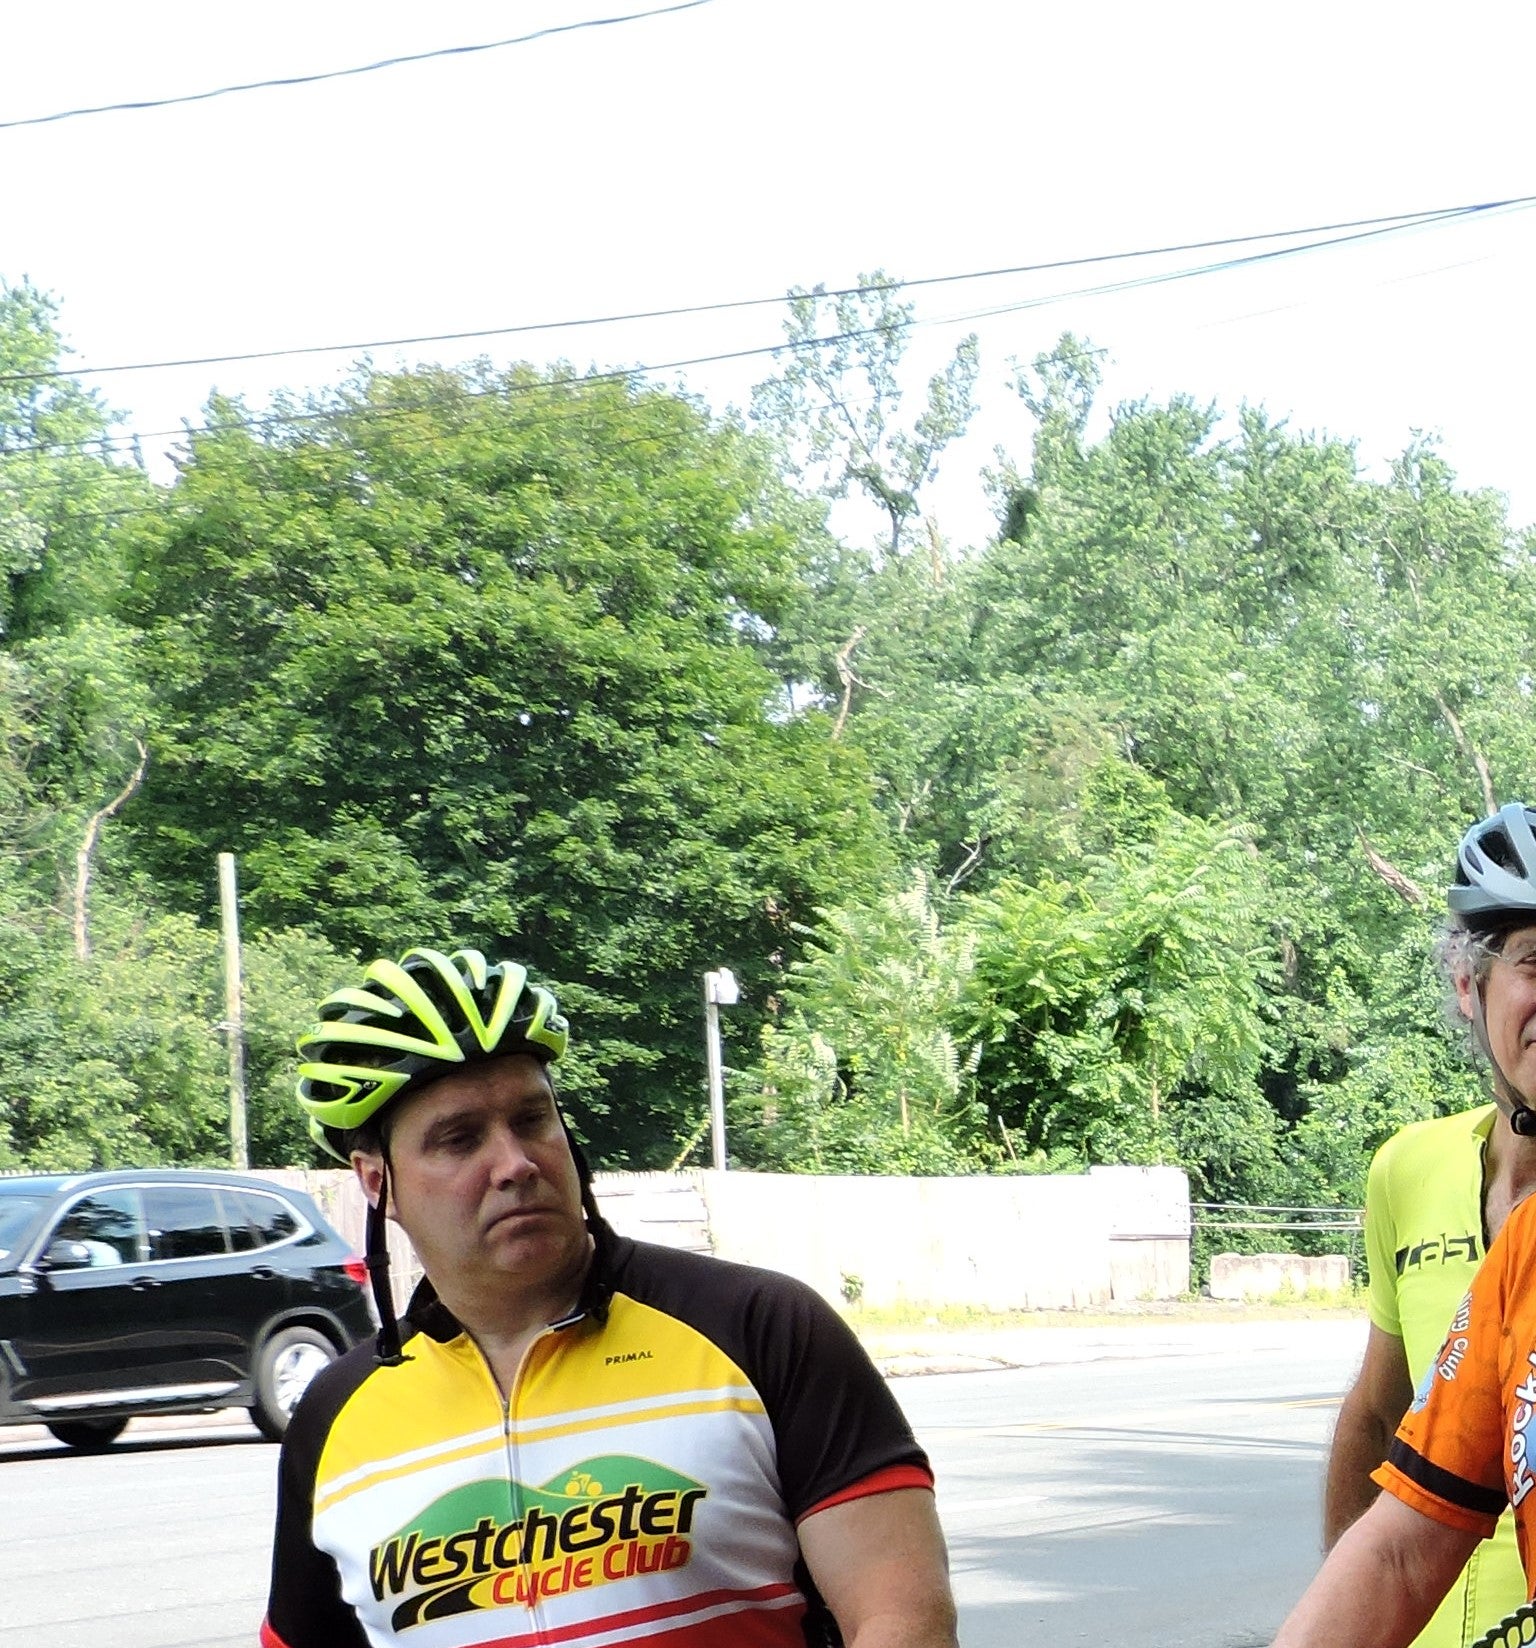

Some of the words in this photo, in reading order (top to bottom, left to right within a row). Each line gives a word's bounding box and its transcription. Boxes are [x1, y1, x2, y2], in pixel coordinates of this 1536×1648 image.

[605, 1350, 653, 1366] PRIMAL
[369, 1484, 706, 1603] Westchester
[492, 1555, 593, 1608] Cycle
[603, 1536, 691, 1581] Club
